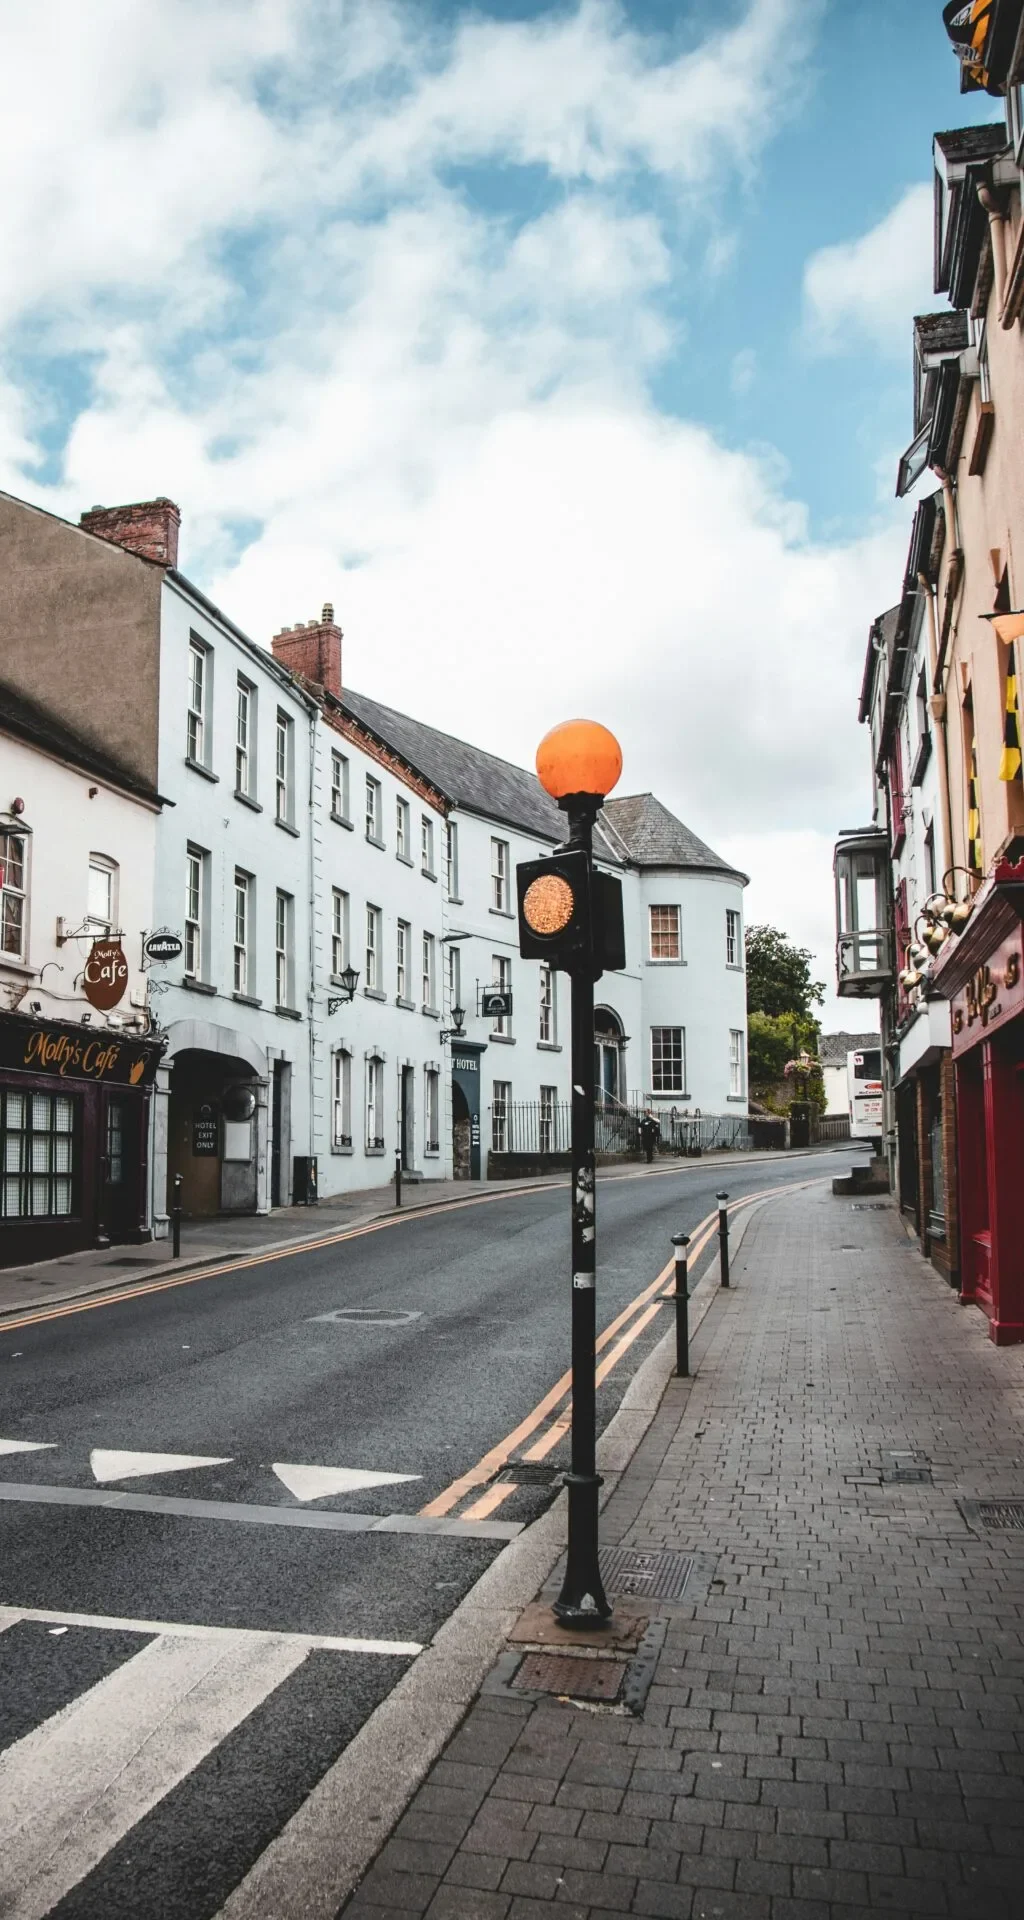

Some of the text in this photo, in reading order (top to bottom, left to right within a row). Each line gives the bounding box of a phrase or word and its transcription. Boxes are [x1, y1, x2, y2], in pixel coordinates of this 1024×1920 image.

[148, 941, 181, 952] LAVAZZA
[94, 949, 120, 960] Molly's
[84, 960, 127, 986] Cafe
[23, 1031, 120, 1079] Molly's Café
[456, 1058, 478, 1071] HOTEL
[198, 1131, 213, 1139] EXIT
[196, 1141, 215, 1149] ONLY
